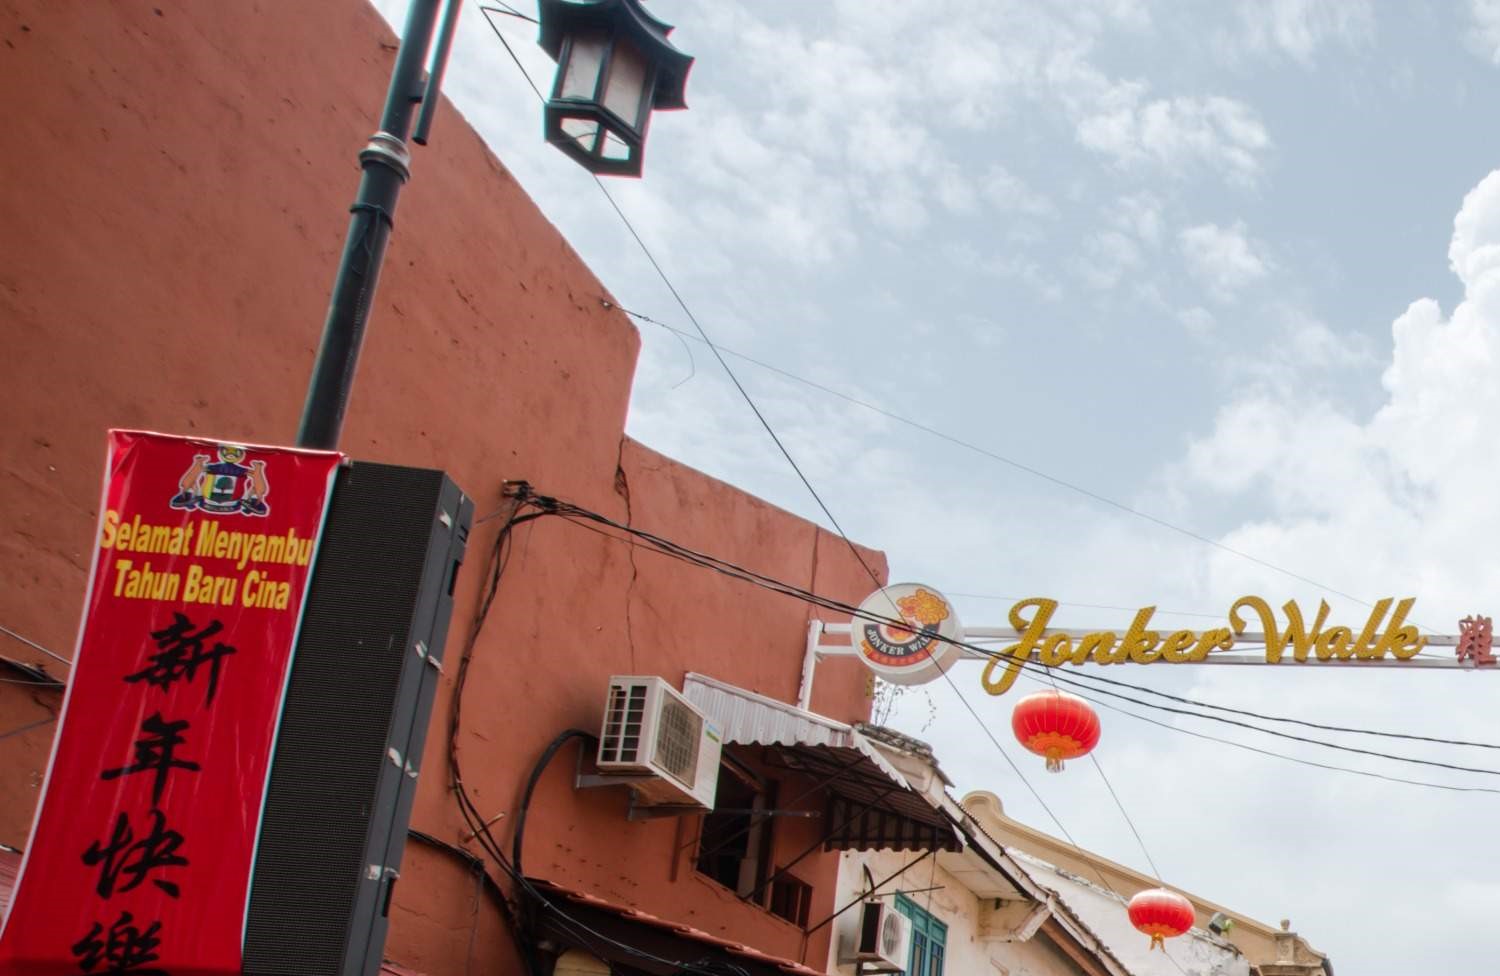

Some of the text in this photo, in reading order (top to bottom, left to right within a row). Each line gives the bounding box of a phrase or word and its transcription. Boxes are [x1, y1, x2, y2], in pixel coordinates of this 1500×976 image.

[100, 509, 194, 557] Selamat
[114, 559, 290, 611] Tahun Baru Cina
[866, 628, 905, 656] JONKER
[981, 594, 1431, 697] Jonker Walk
